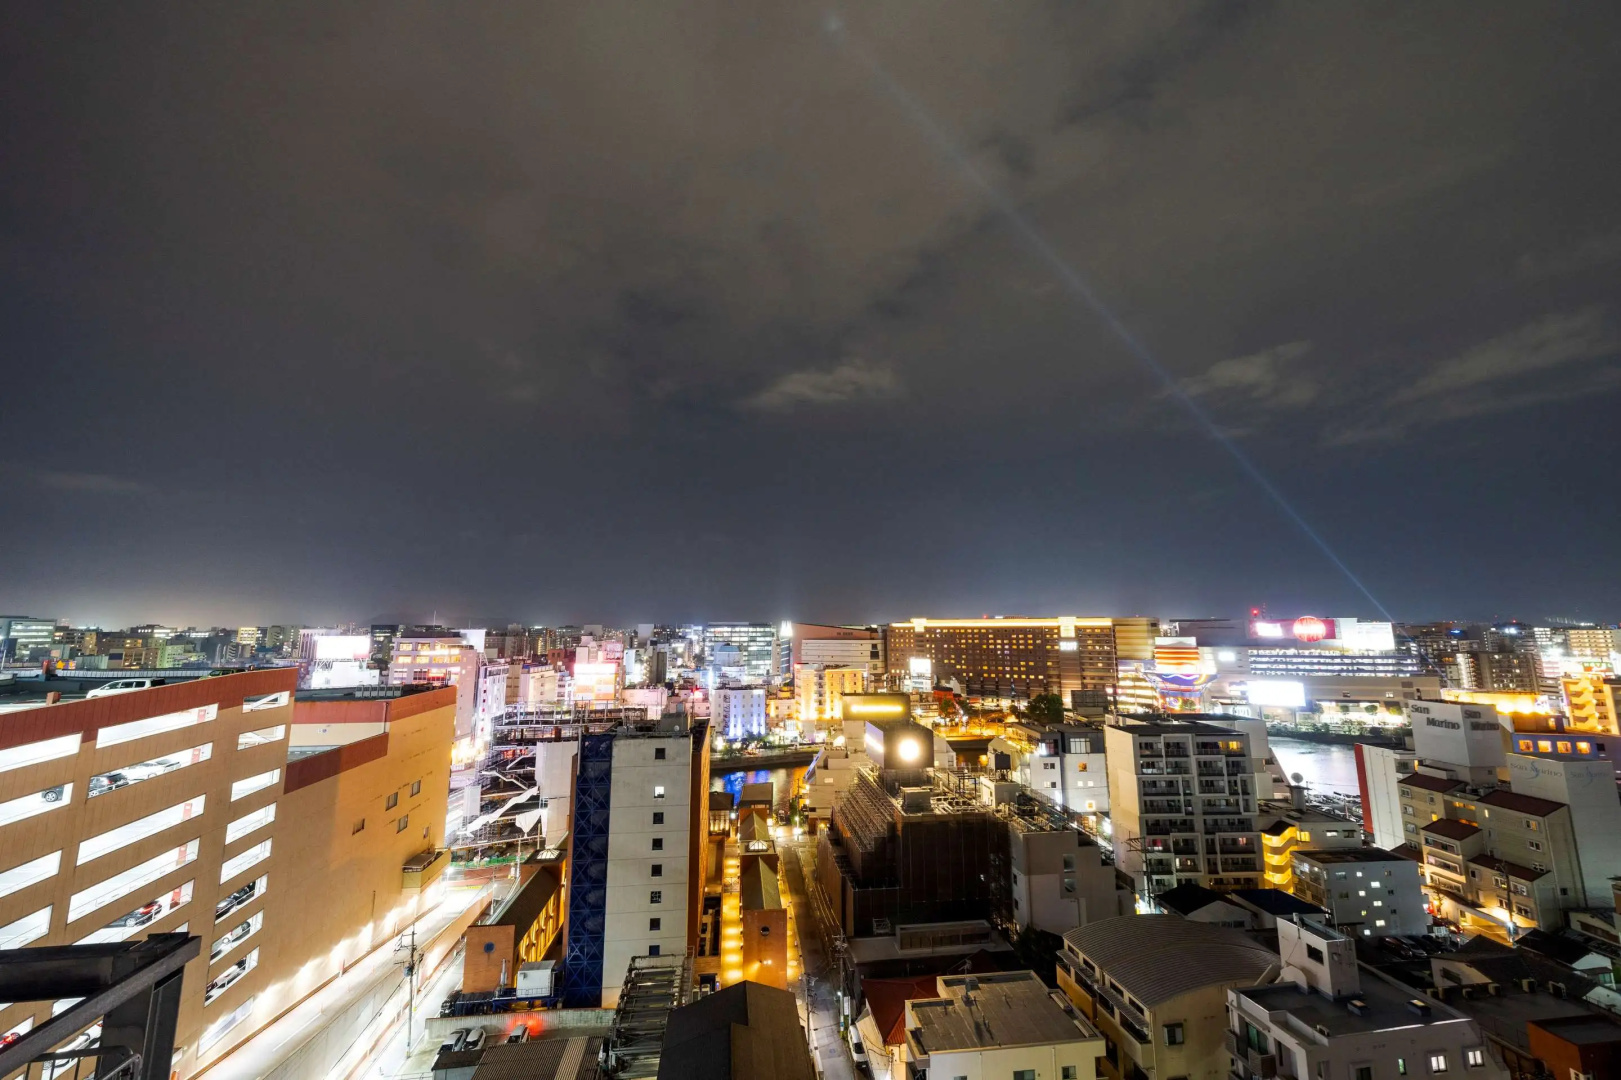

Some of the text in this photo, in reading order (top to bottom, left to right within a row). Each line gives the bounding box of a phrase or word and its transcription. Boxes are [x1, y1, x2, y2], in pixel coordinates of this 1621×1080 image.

[1411, 704, 1430, 715] San
[1464, 709, 1482, 719] San
[1426, 717, 1461, 731] Marino
